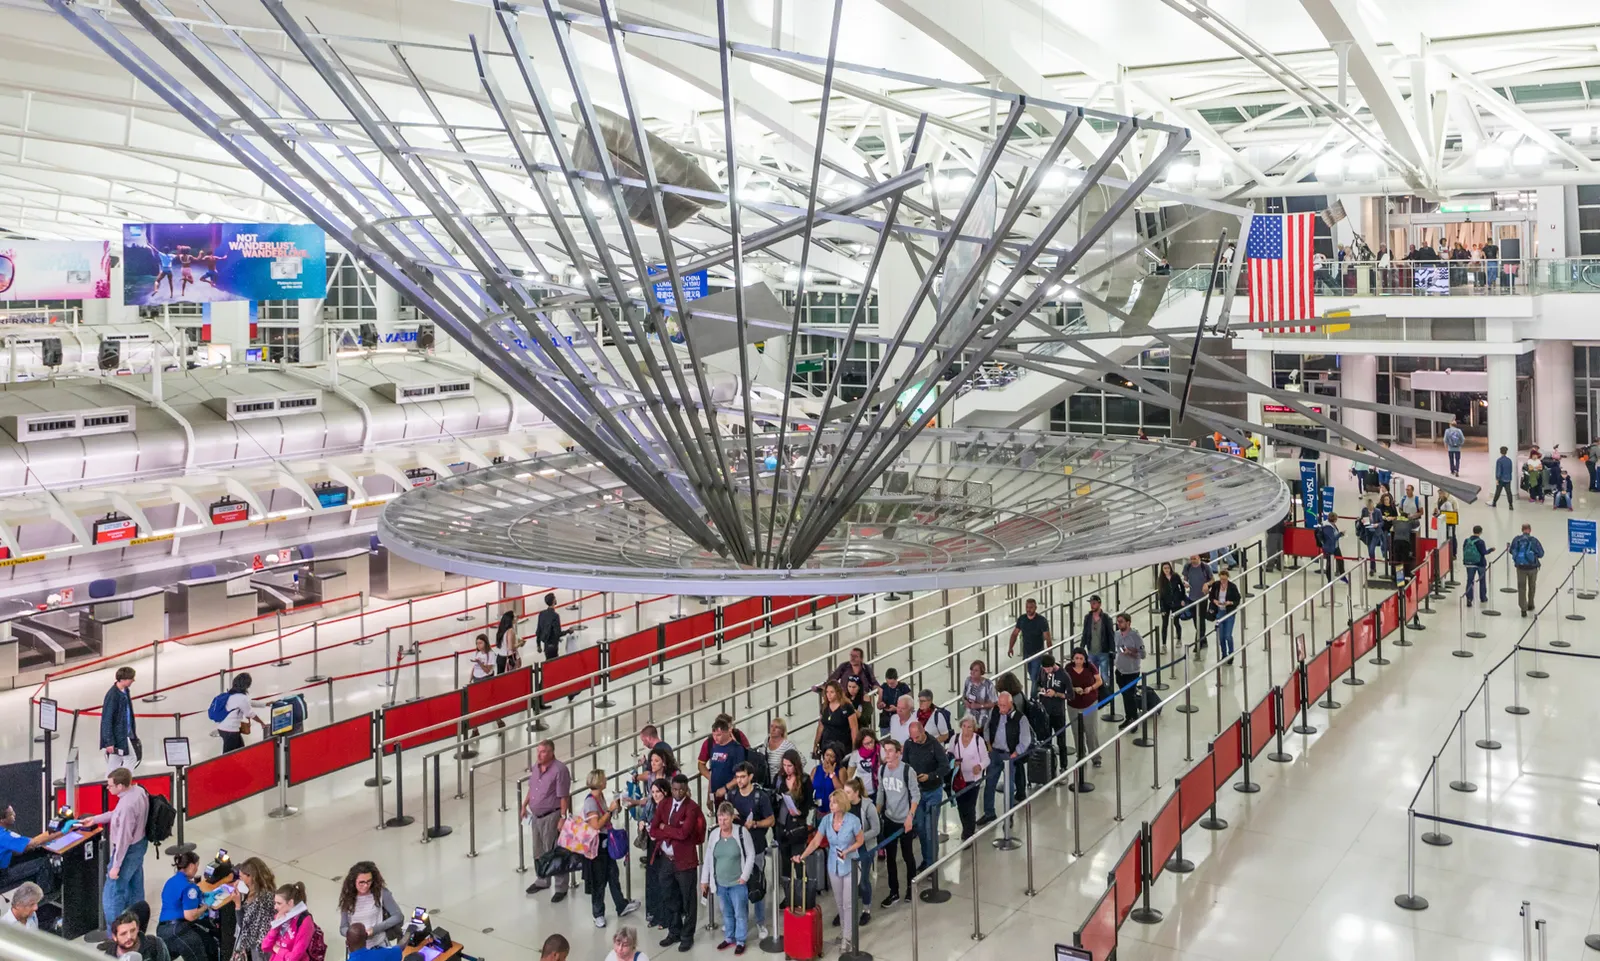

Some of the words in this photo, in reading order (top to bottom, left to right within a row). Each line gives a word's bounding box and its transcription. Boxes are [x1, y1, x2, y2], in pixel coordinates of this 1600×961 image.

[236, 234, 258, 242] NOT
[1306, 478, 1315, 493] TSA
[1306, 494, 1315, 508] Pre
[882, 776, 904, 793] GAP
